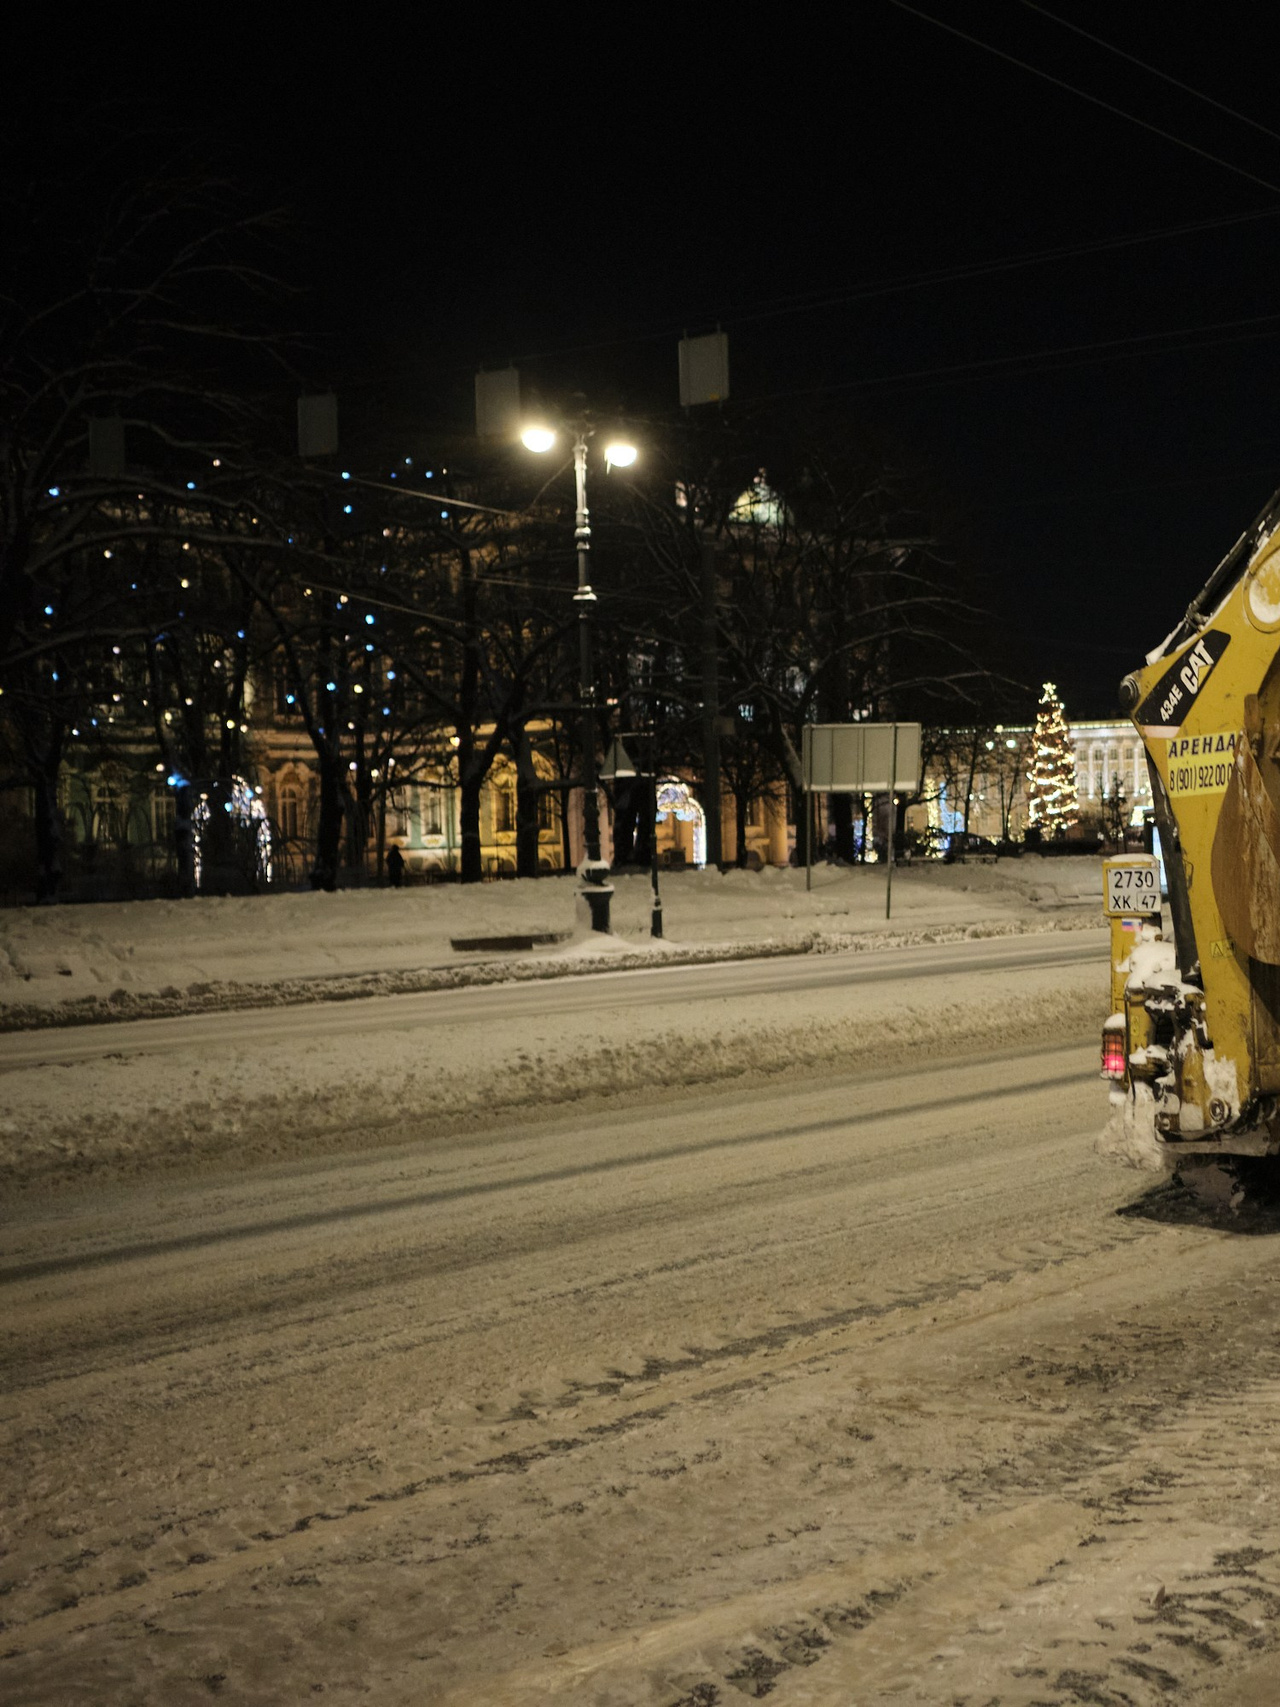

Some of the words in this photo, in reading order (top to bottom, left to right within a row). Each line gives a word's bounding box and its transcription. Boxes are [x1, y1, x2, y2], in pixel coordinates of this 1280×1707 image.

[1160, 684, 1183, 722] 434E
[1180, 639, 1214, 694] CAT
[1168, 733, 1236, 759] АРЕНДА
[1170, 771, 1175, 791] 8
[1176, 765, 1197, 793] (901)
[1198, 765, 1214, 788] 922
[1114, 871, 1154, 889] 2730
[1112, 895, 1131, 910] ХК
[1141, 895, 1157, 909] 47
